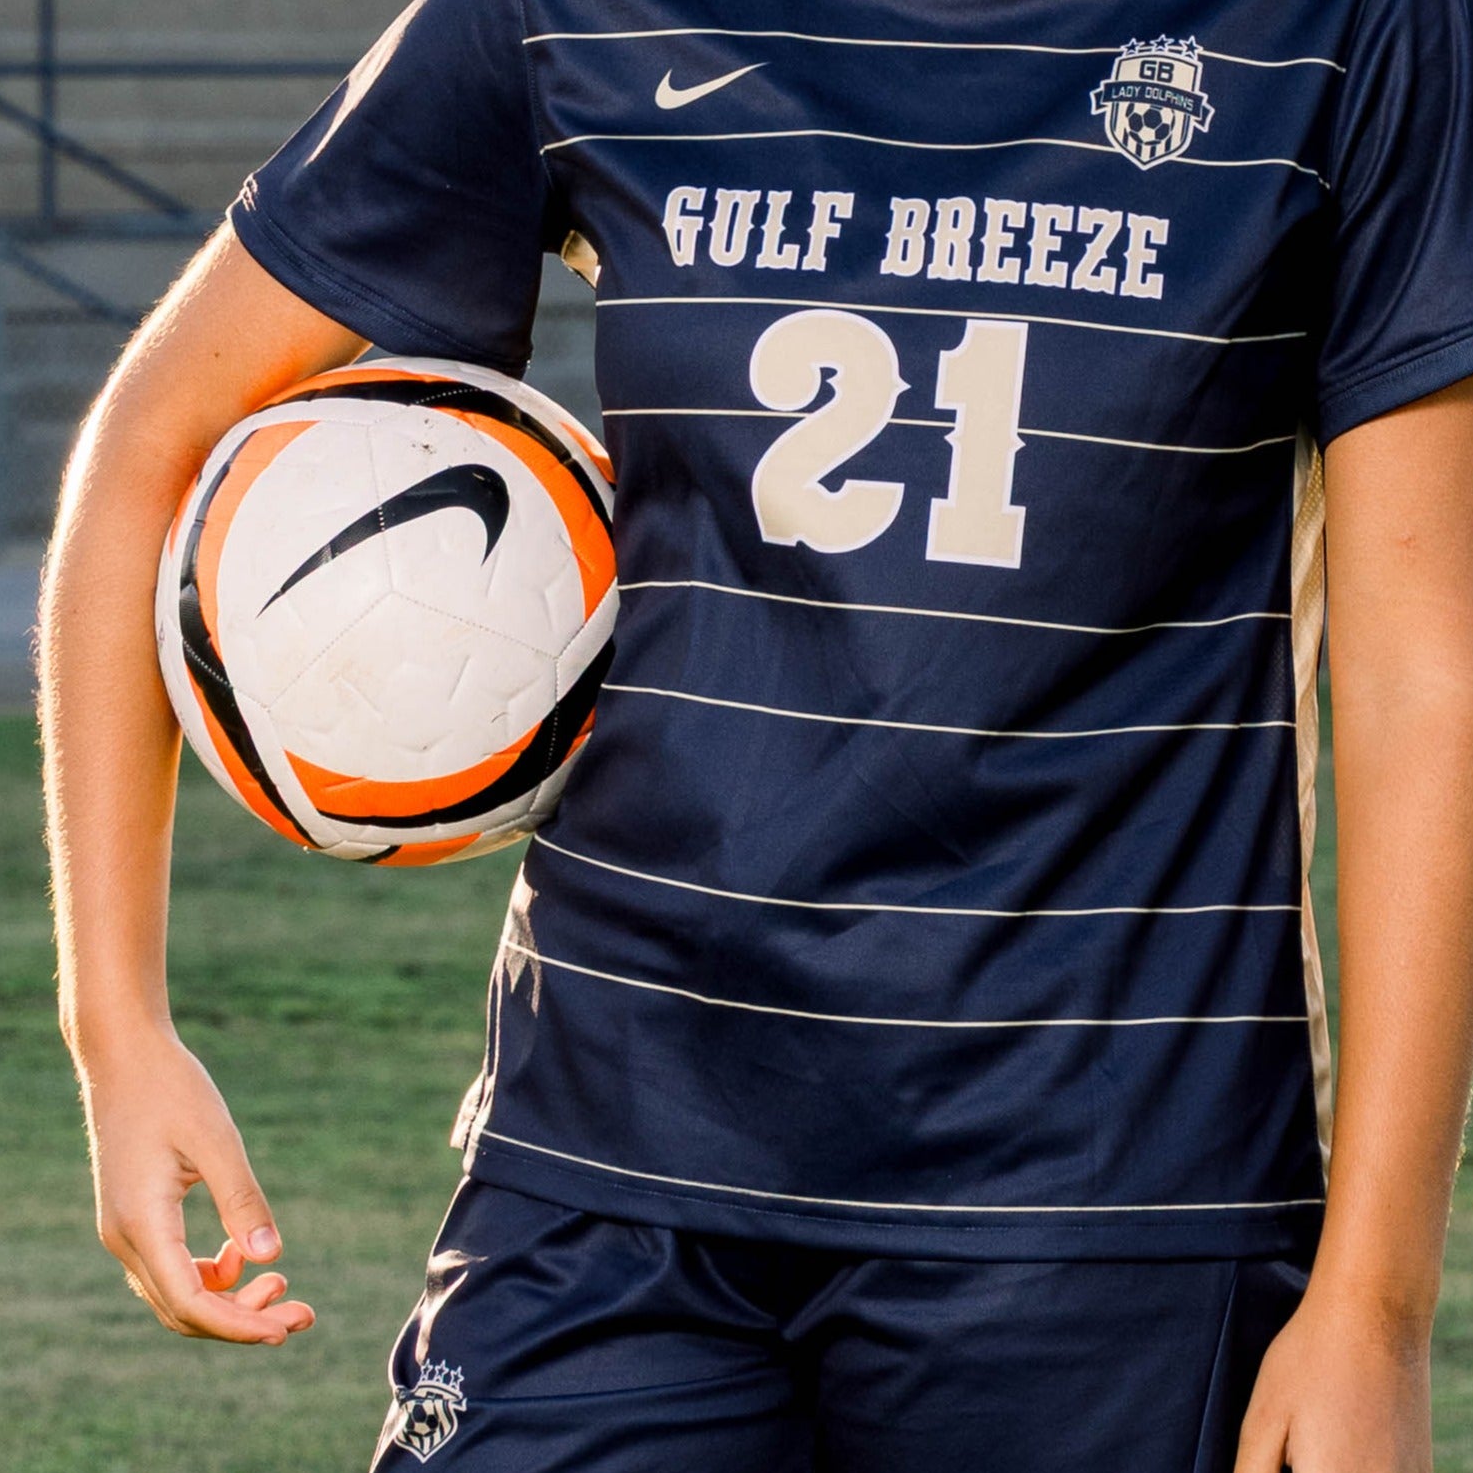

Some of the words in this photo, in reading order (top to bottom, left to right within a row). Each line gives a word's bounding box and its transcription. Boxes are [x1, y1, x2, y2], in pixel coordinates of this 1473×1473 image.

[1111, 85, 1141, 98] LADY
[1144, 86, 1194, 111] DOLPHINS
[1139, 60, 1174, 83] GB
[662, 186, 855, 271] GULF
[881, 195, 1170, 300] BREEZE
[748, 308, 1029, 570] 21
